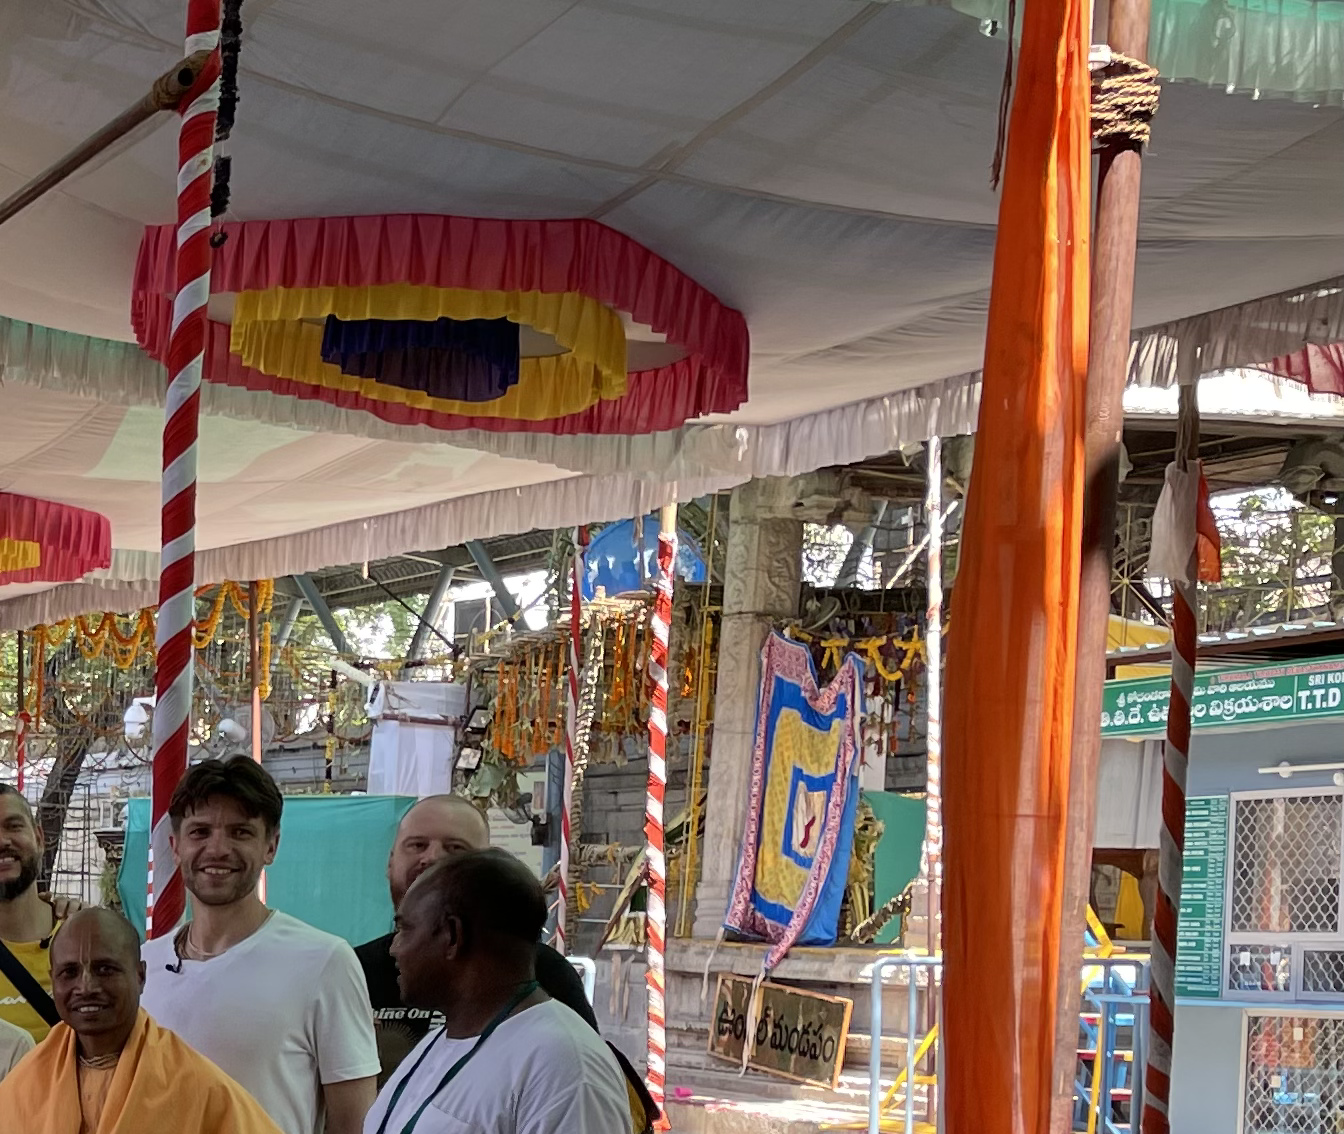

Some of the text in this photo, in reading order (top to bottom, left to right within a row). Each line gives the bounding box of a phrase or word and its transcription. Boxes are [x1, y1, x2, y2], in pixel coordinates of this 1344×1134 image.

[1308, 674, 1326, 687] SRI
[1209, 695, 1293, 721] విక్రయశాల
[1298, 687, 1342, 711] T.T.D
[407, 1008, 431, 1019] On
